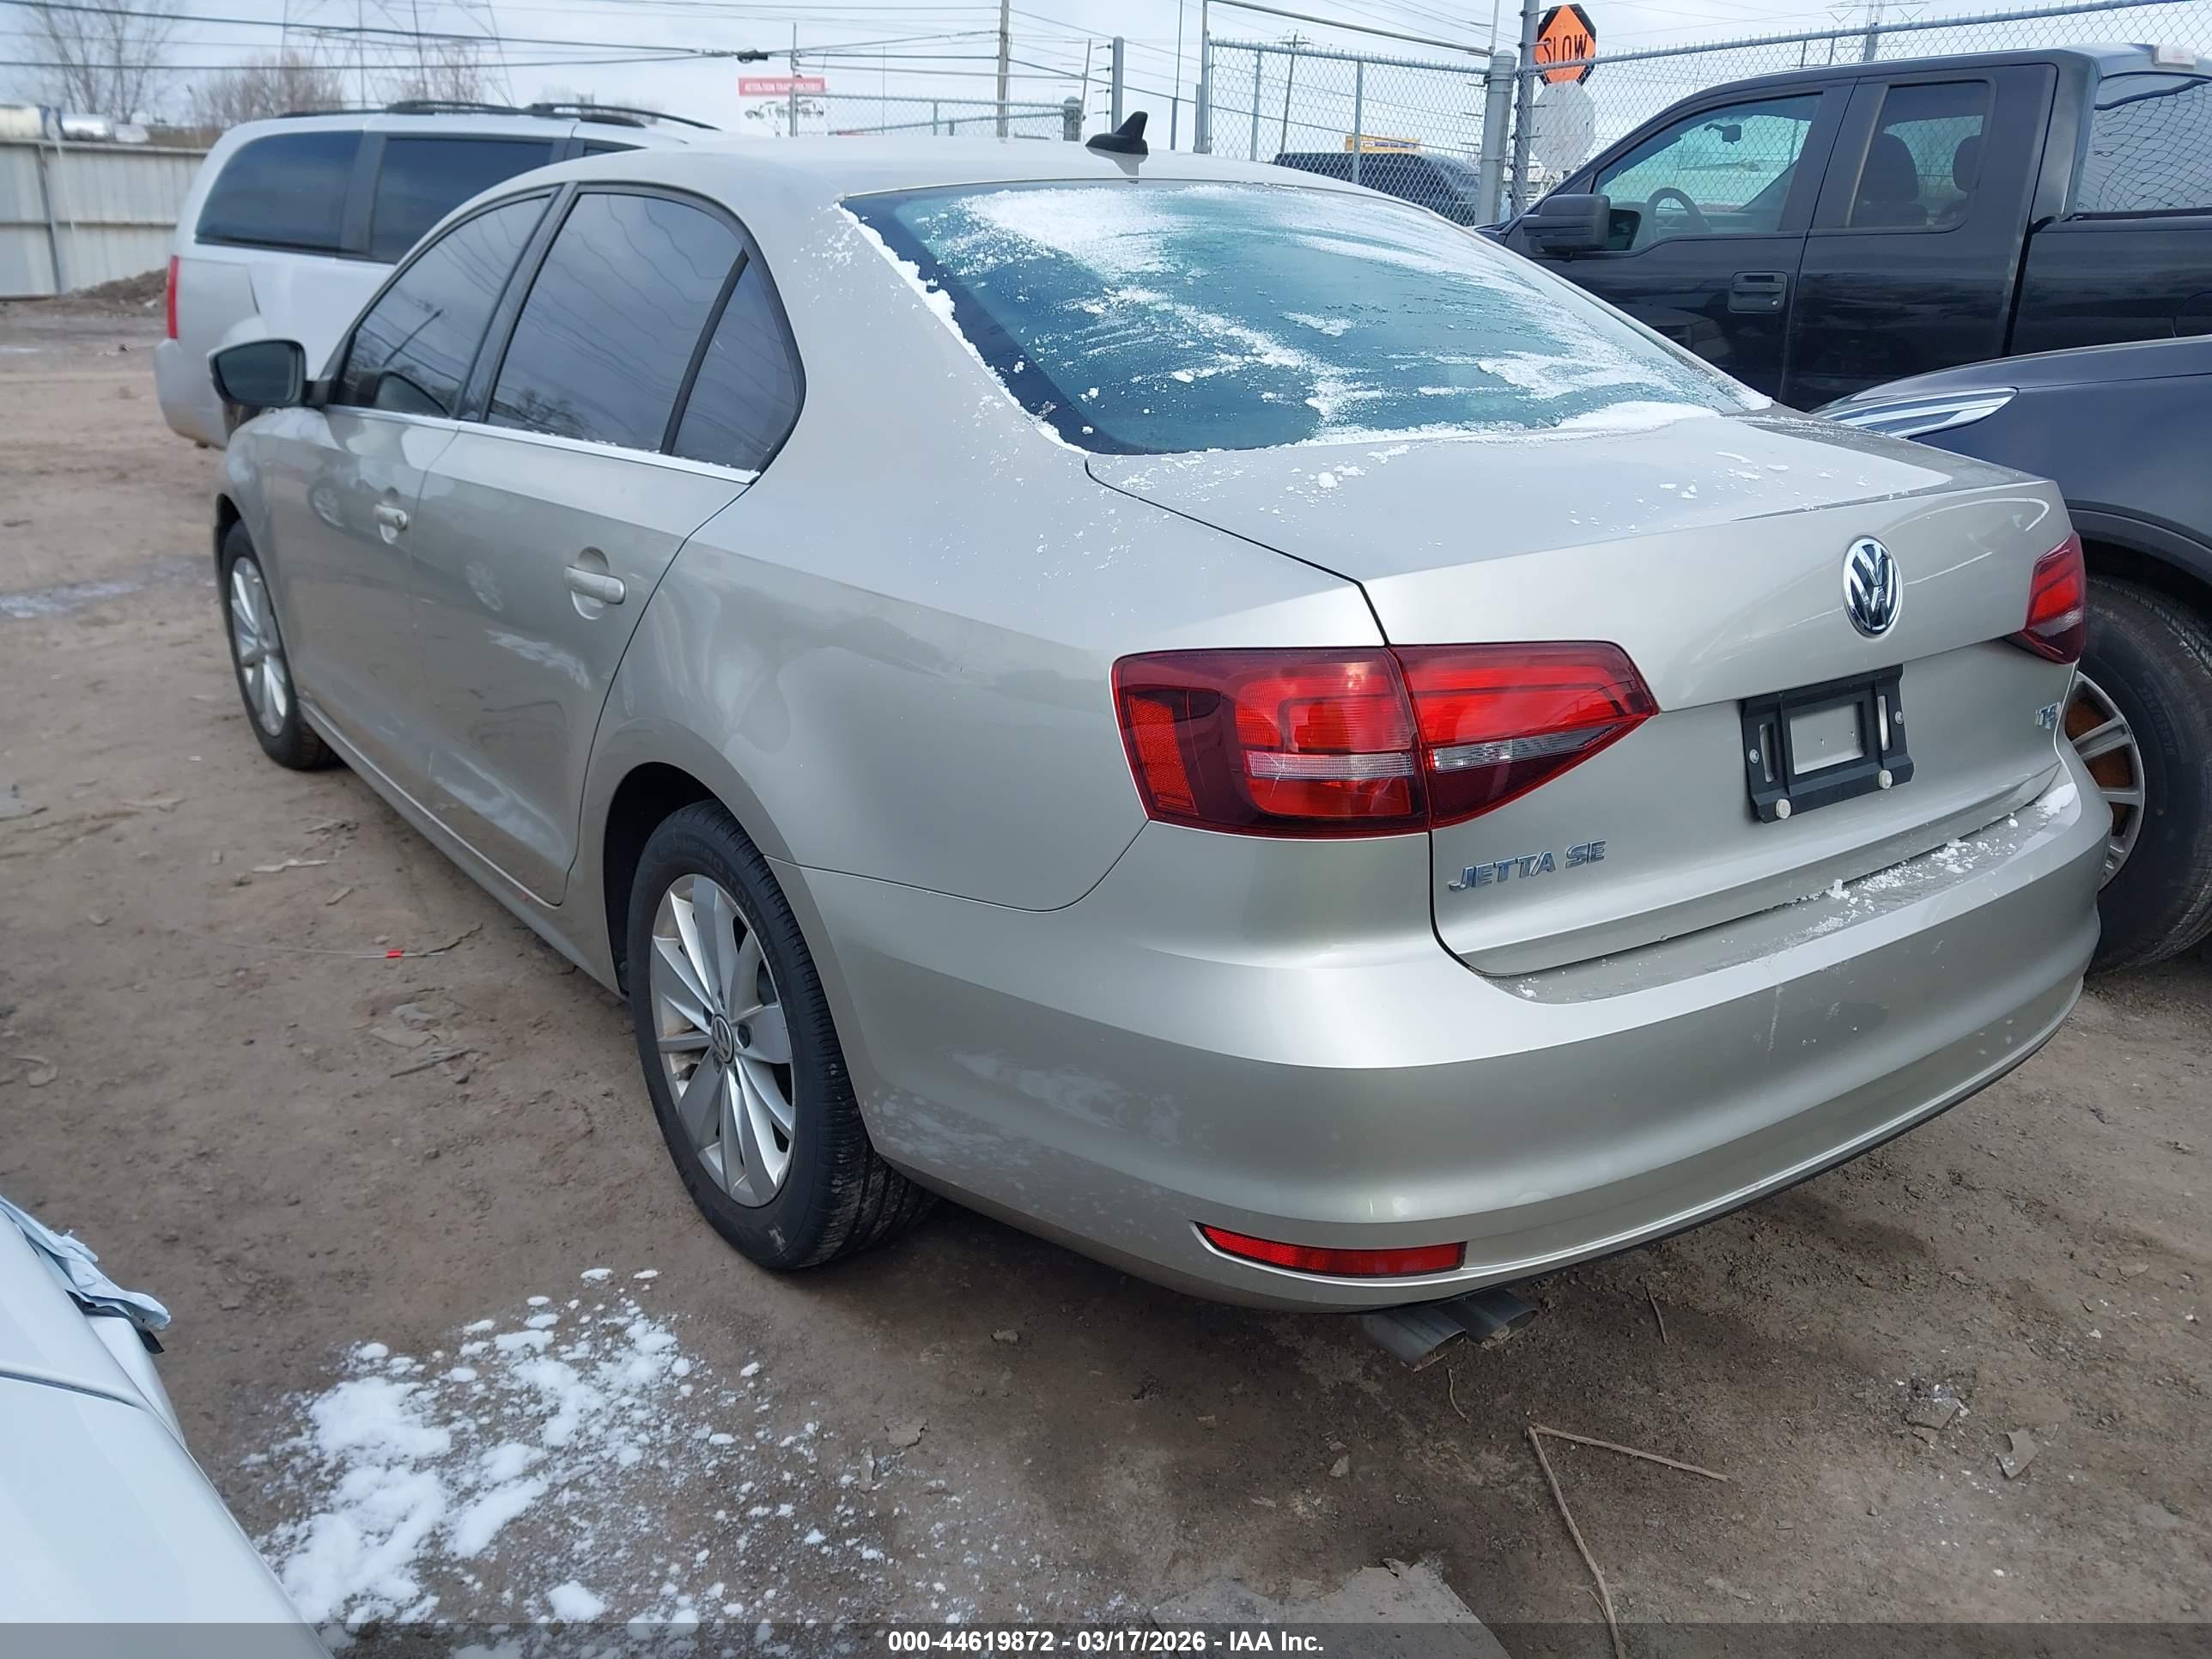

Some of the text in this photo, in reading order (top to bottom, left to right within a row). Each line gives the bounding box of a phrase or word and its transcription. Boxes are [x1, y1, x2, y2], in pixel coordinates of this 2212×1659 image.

[1543, 33, 1588, 64] SLOW
[1448, 839, 1607, 892] JETTA SE
